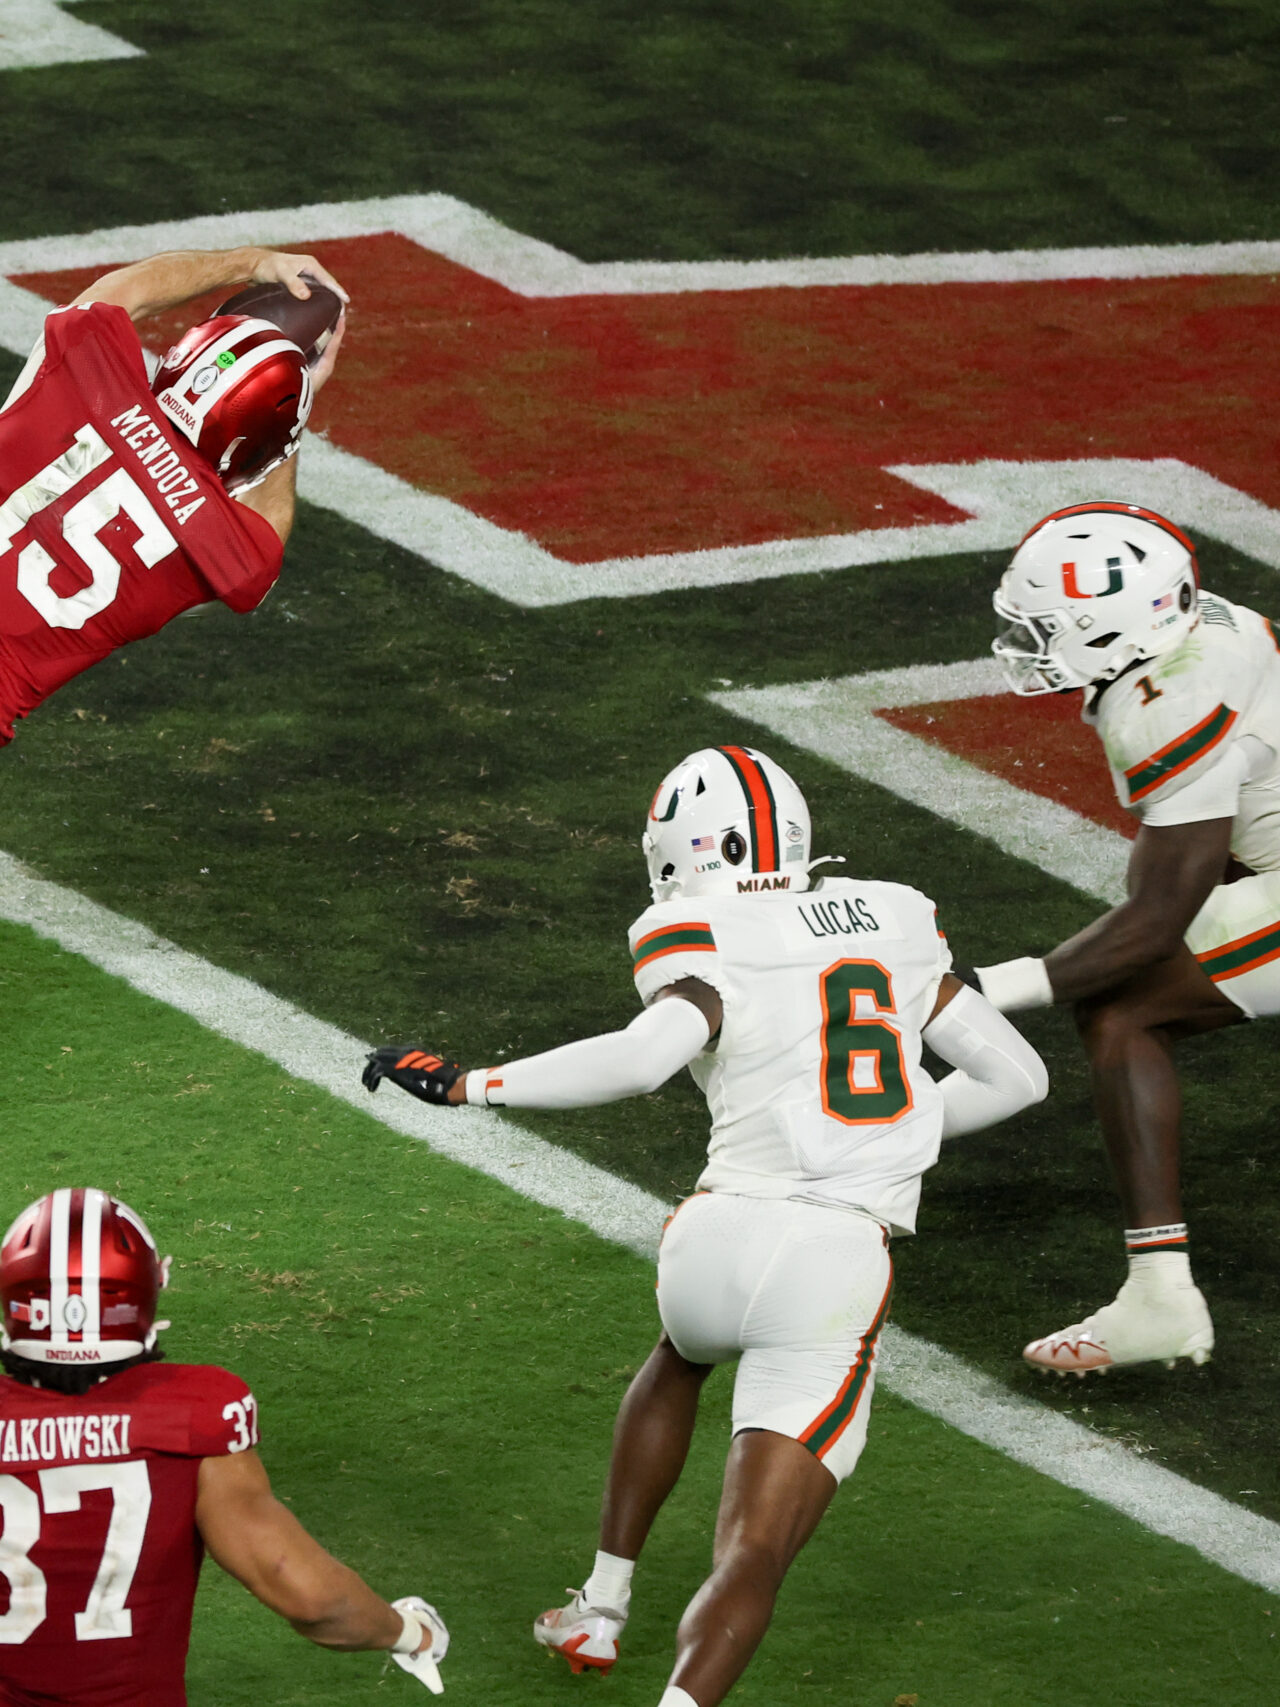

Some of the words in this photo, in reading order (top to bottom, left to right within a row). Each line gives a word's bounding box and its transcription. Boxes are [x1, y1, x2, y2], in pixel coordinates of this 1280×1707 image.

[161, 394, 197, 430] INDIANA
[110, 403, 207, 525] MENDOZA
[1134, 675, 1164, 707] 1
[736, 877, 791, 893] MIAMI
[798, 898, 880, 937] LUCAS
[819, 958, 914, 1126] 6
[46, 1350, 101, 1362] INDIANA
[222, 1394, 259, 1454] 37
